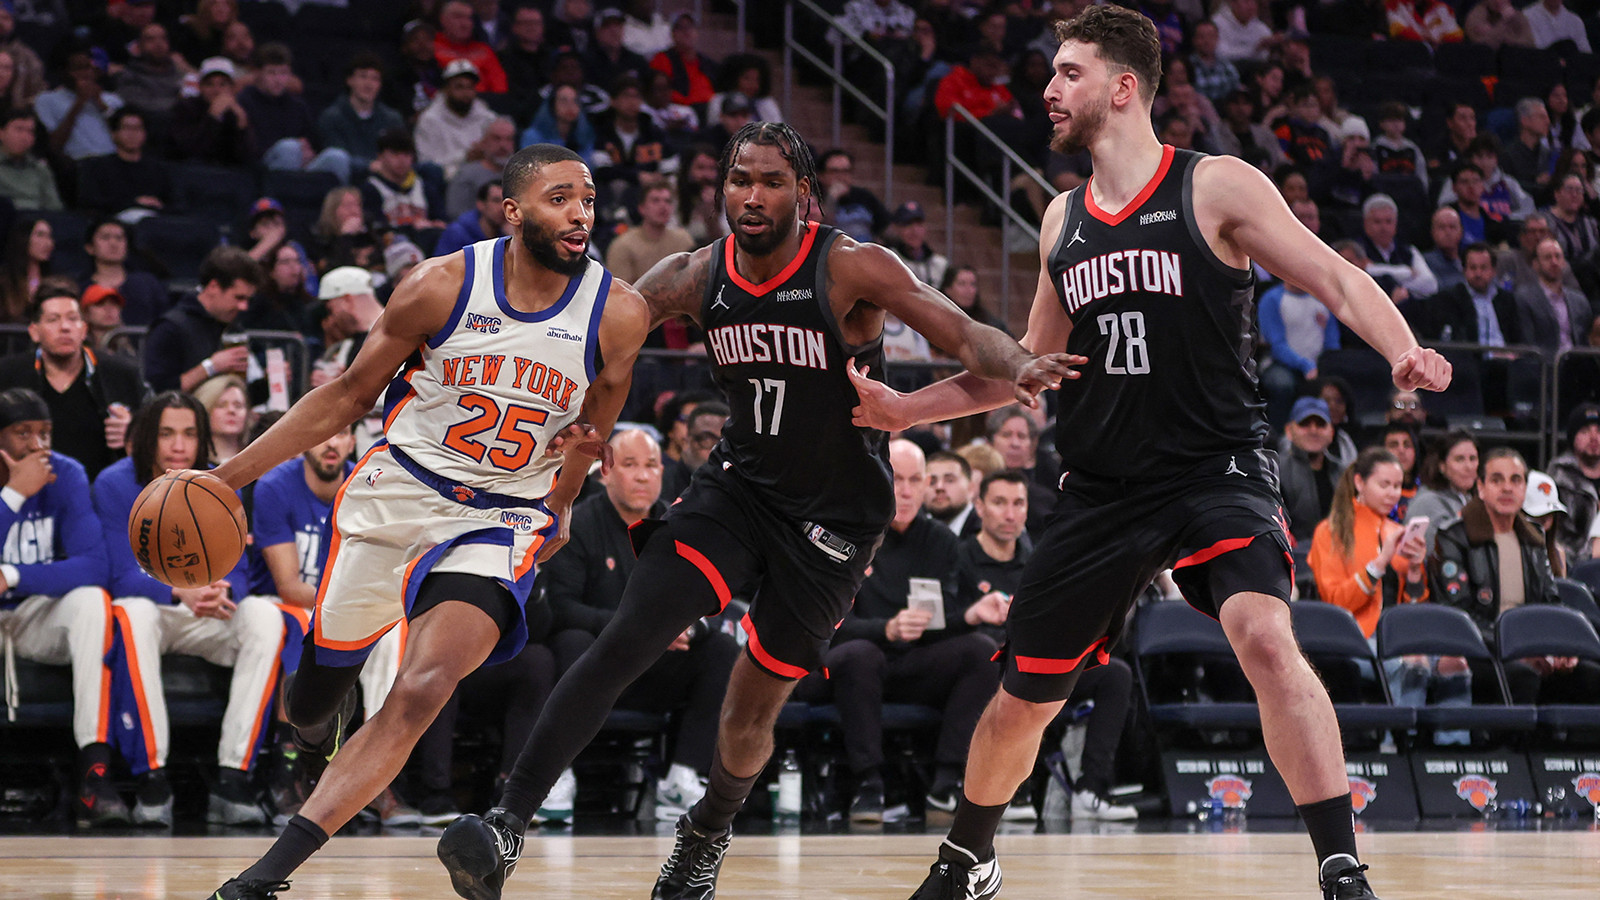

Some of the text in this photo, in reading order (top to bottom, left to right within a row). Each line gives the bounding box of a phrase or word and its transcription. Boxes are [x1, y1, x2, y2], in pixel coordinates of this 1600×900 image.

[1062, 249, 1184, 315] HOUSTON
[465, 312, 502, 334] NYC
[546, 331, 583, 342] abu dhabi
[707, 323, 828, 371] HOUSTON
[1096, 311, 1151, 375] 28
[442, 355, 578, 412] NEW YORK
[748, 378, 786, 436] 17
[442, 392, 550, 472] 25
[500, 511, 532, 531] NYC
